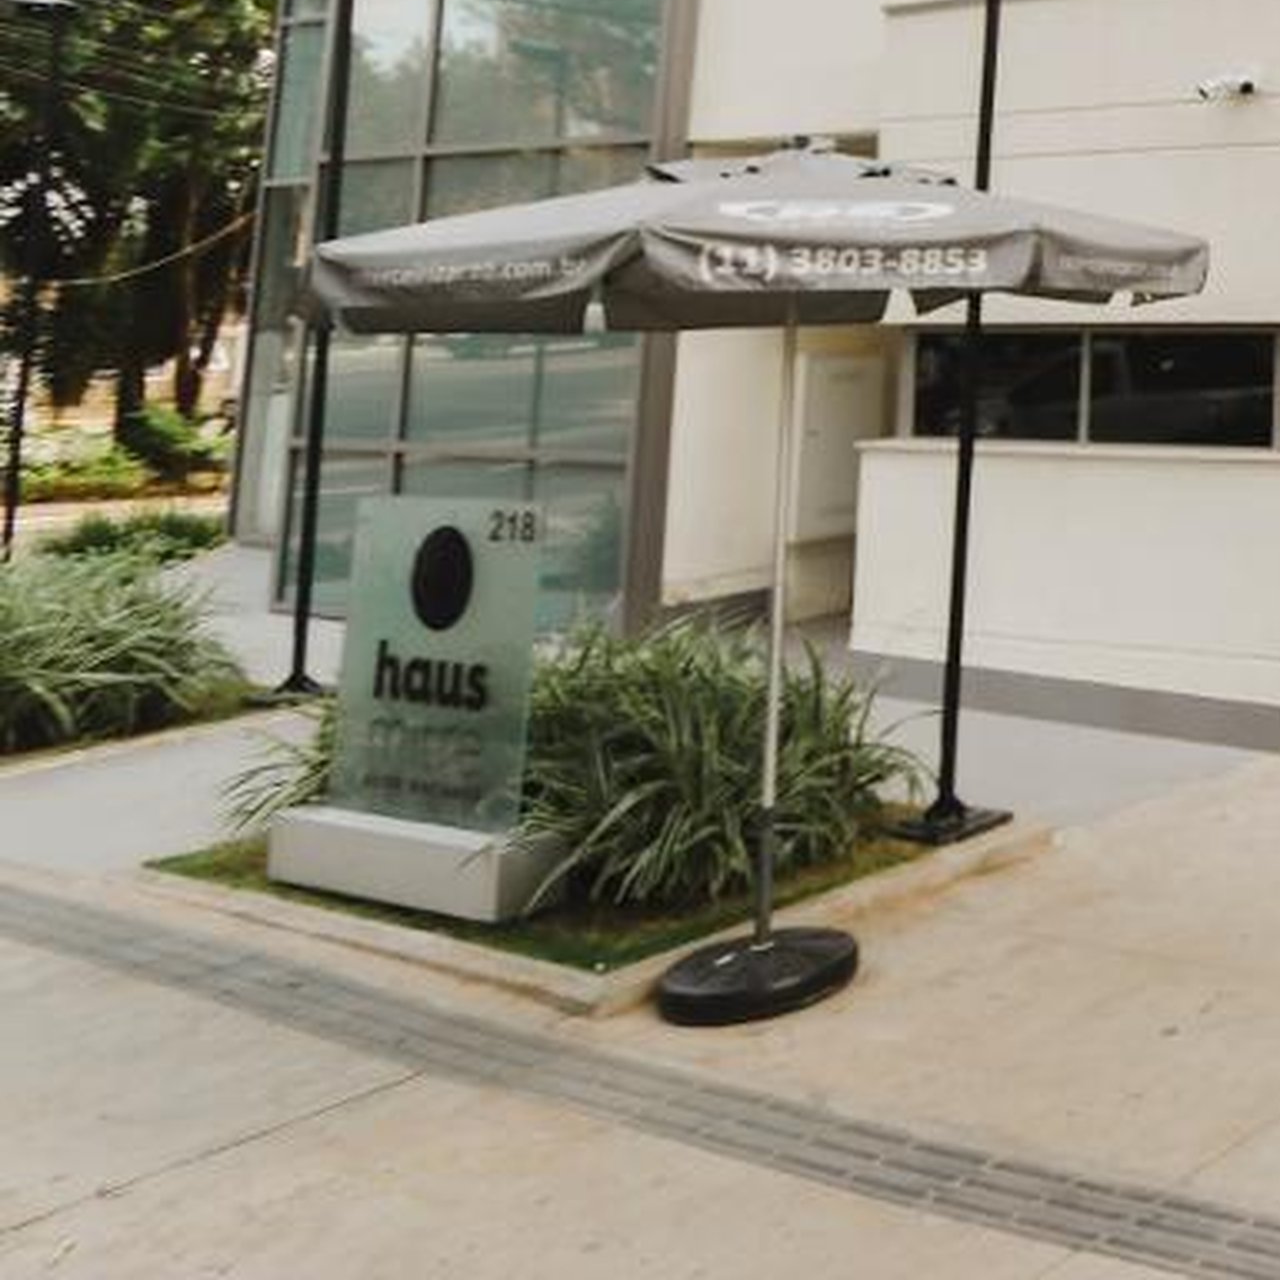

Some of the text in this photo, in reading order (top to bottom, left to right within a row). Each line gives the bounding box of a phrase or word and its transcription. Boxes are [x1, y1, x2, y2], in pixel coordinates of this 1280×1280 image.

[792, 247, 989, 275] 3803-8853
[488, 510, 535, 543] 218
[373, 639, 490, 711] haus
